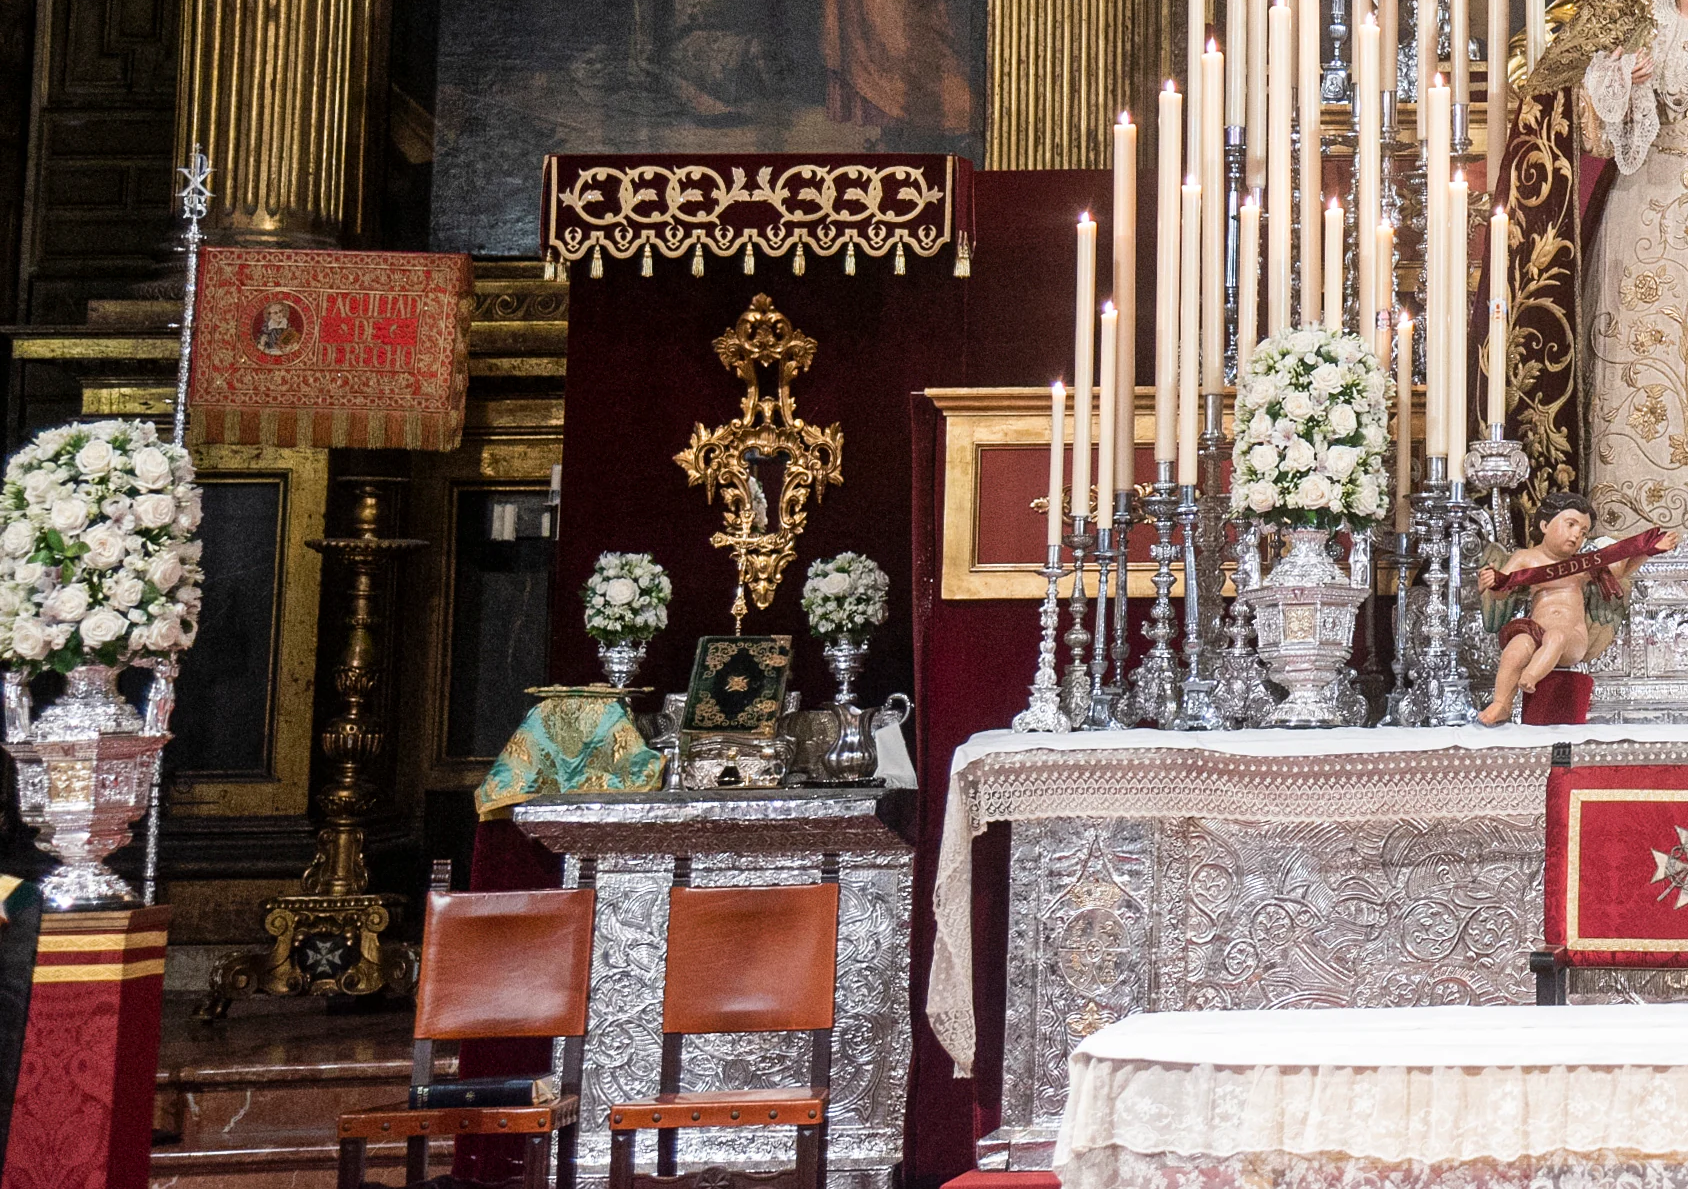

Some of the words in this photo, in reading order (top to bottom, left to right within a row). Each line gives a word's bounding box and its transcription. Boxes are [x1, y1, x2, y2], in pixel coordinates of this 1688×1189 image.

[321, 291, 422, 318] FACULTAD
[354, 318, 383, 343] DE
[319, 342, 417, 371] DERECHO
[1546, 552, 1602, 579] SEDES
